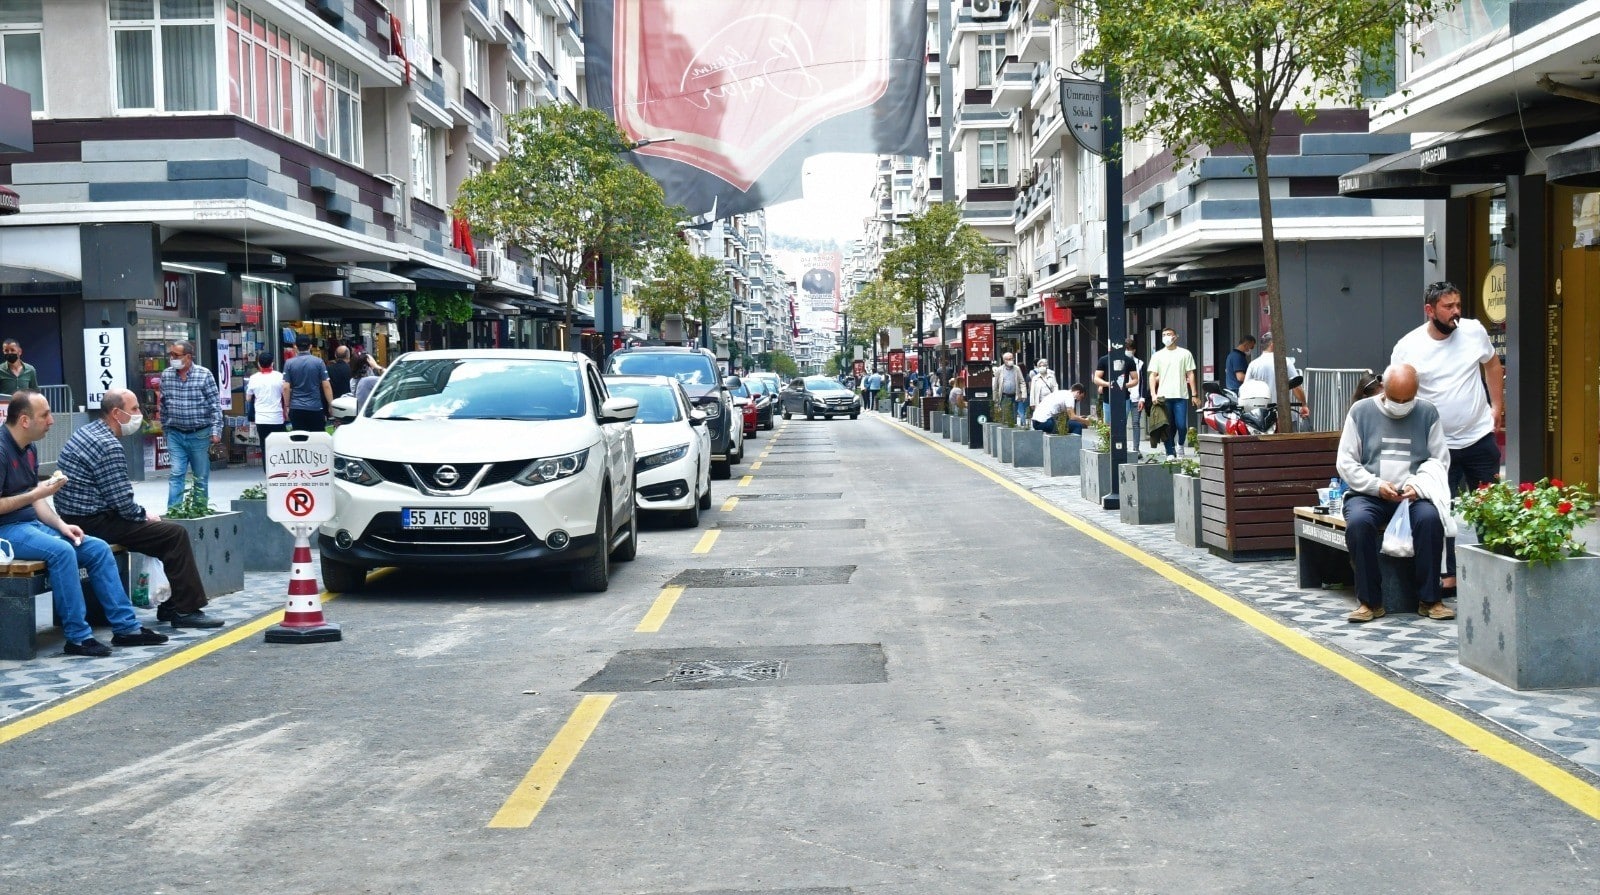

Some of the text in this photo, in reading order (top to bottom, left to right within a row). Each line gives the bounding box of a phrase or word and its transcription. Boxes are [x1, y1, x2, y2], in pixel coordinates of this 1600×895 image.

[1066, 87, 1100, 104] Ümraniye
[1072, 106, 1094, 117] Sokak
[7, 306, 57, 314] KULAKLIK
[1487, 294, 1506, 311] perfum
[99, 332, 113, 390] ÖZBAY
[269, 448, 328, 467] ÇALIKUŞU
[411, 511, 426, 525] 55
[434, 511, 457, 525] AFC
[464, 511, 487, 525] 098
